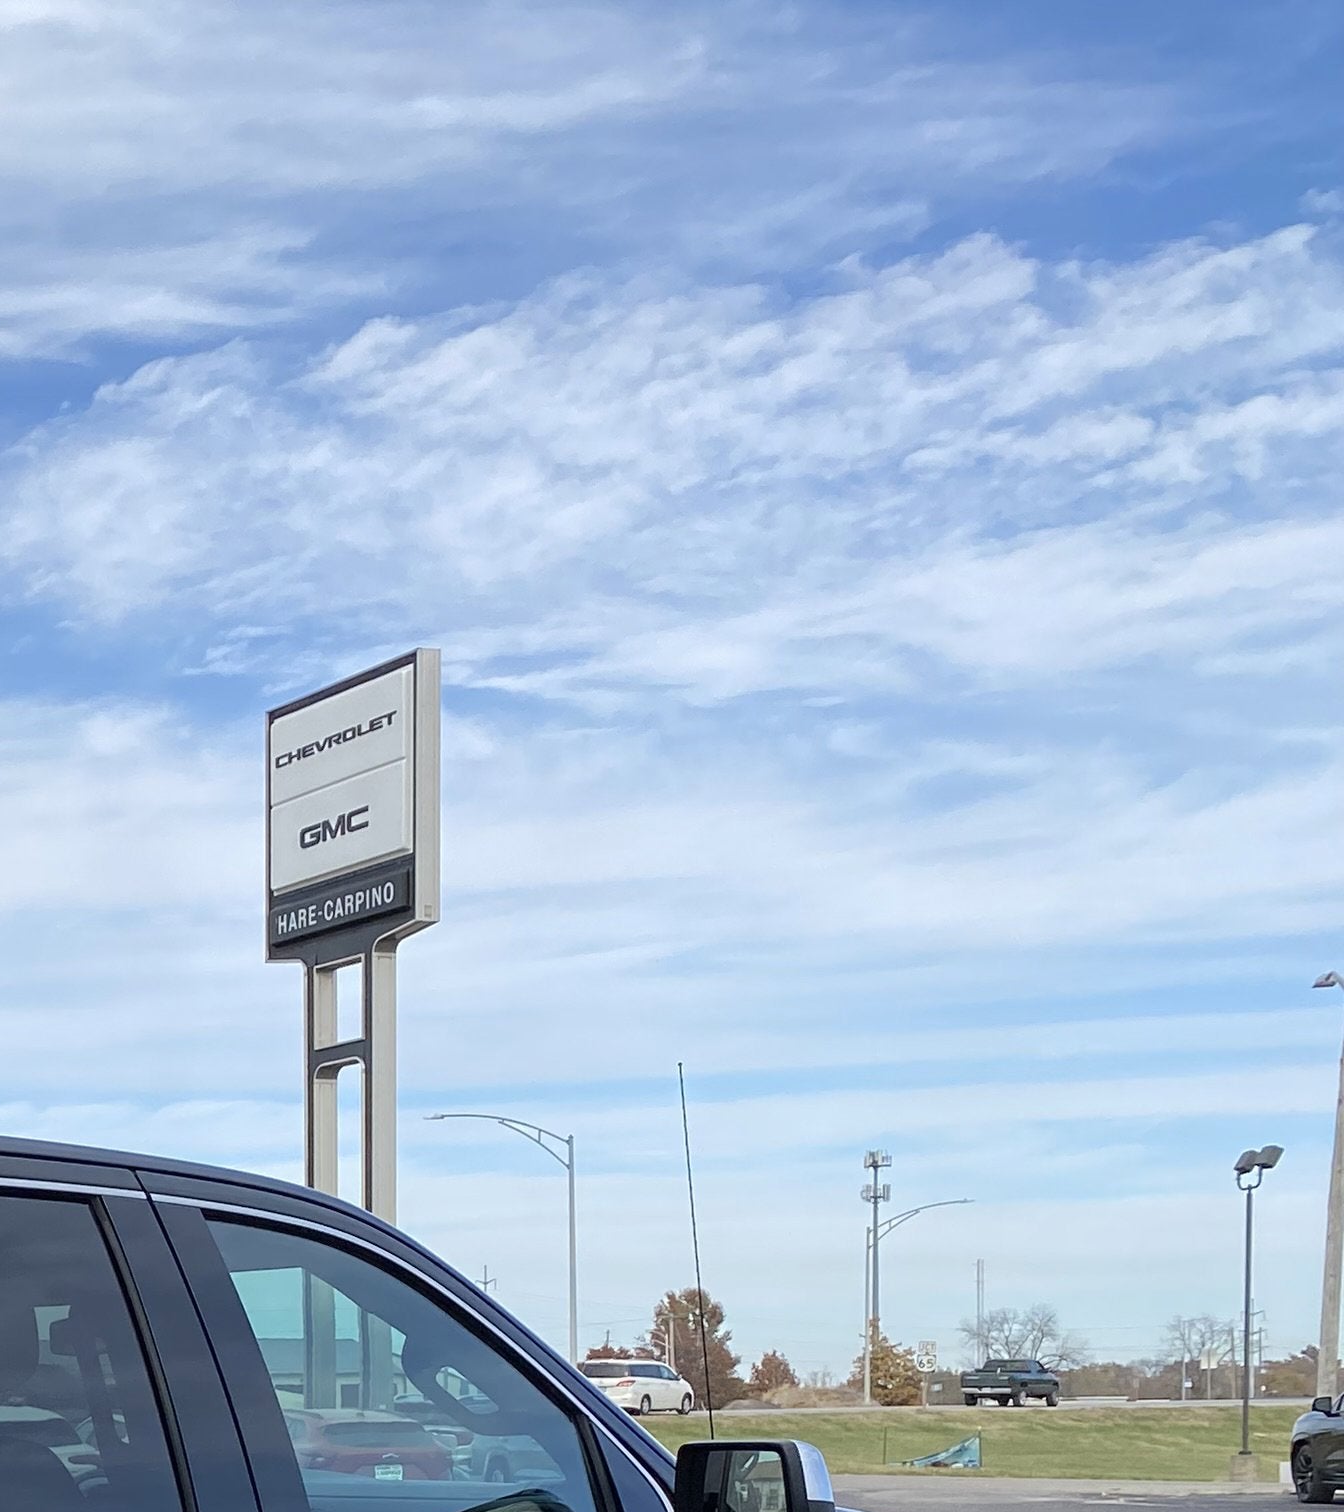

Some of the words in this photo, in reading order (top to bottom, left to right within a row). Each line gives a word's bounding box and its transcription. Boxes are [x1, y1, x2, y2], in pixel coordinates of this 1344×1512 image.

[275, 710, 397, 769] CHEVROLET
[299, 805, 369, 849] GMC
[278, 881, 394, 934] HARE-CARPINO
[918, 1359, 934, 1369] 65
